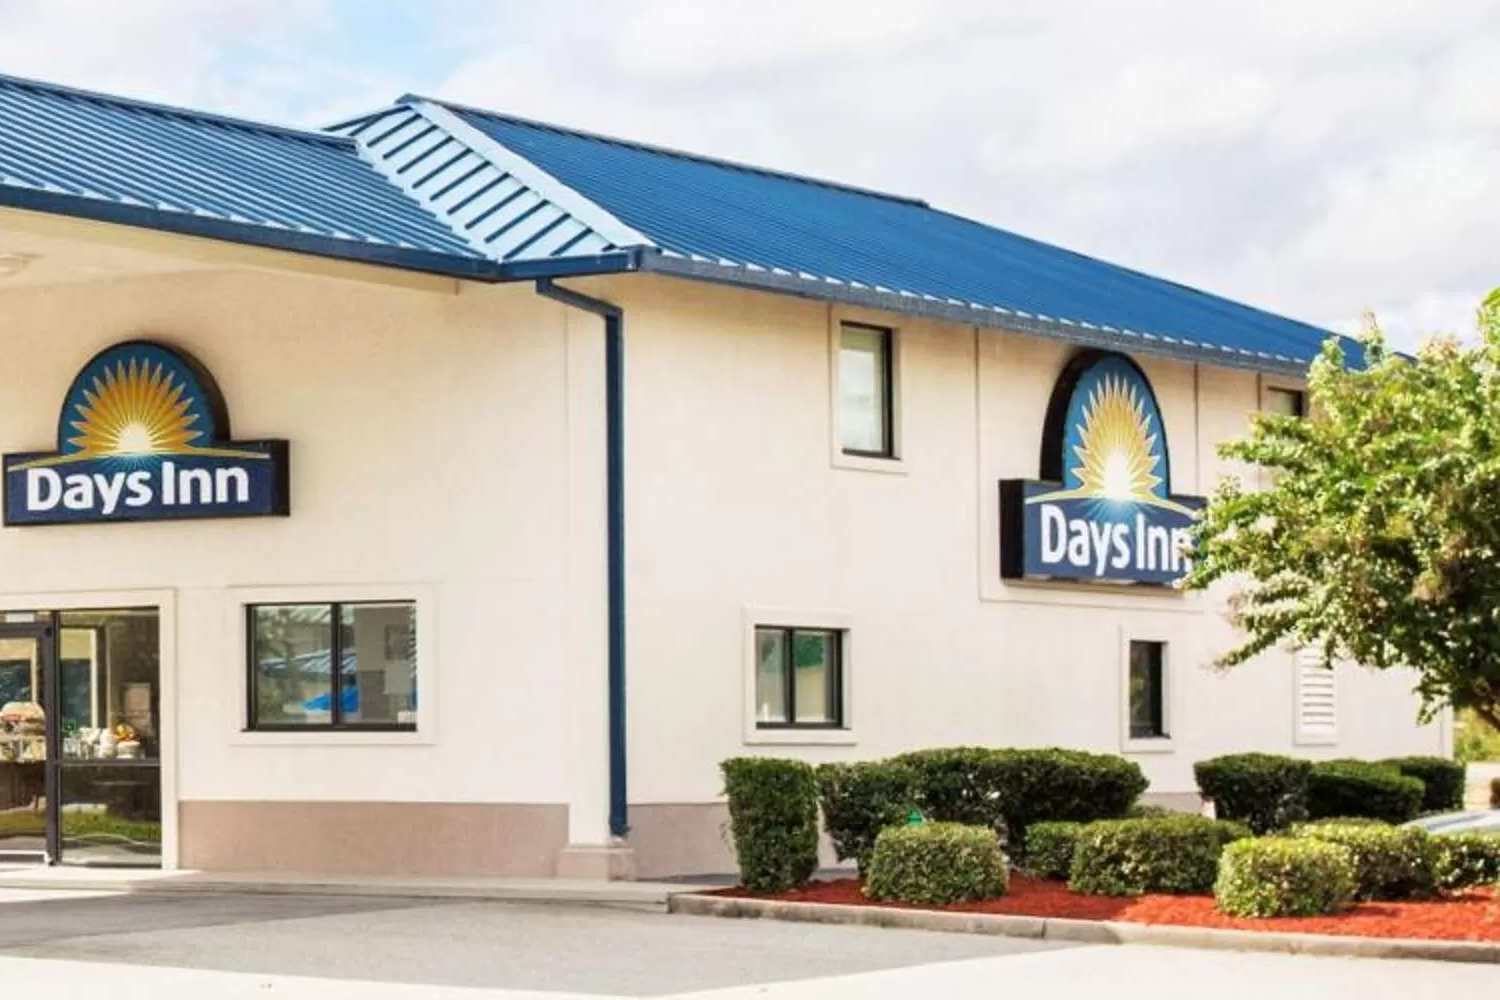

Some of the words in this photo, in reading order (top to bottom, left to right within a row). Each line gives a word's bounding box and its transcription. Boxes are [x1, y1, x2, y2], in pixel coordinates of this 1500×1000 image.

[27, 466, 152, 514] Days
[161, 461, 249, 505] Inn
[1041, 504, 1131, 577] Days
[1136, 512, 1194, 573] Inn
